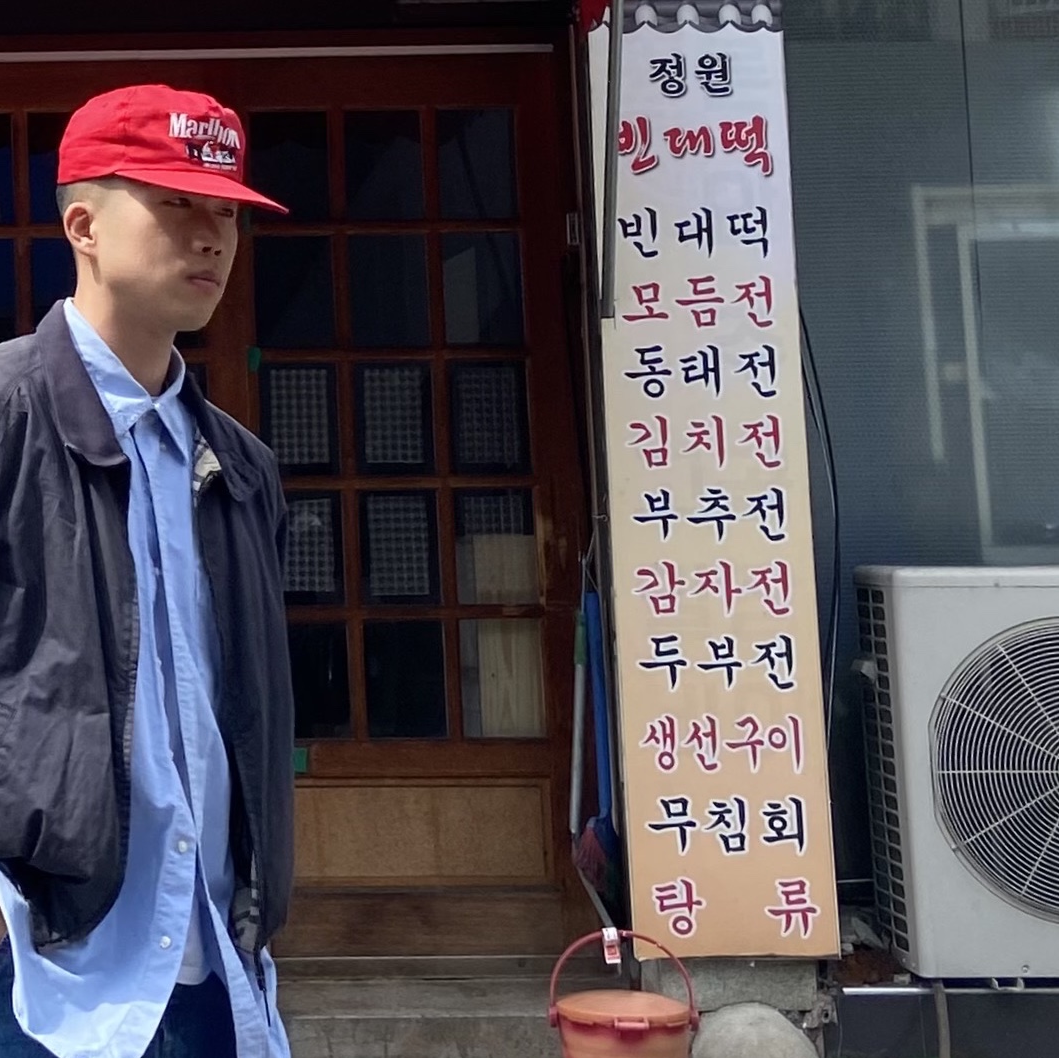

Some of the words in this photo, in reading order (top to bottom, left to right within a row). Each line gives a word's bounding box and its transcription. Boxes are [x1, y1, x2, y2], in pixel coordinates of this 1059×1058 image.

[650, 52, 733, 96] 정원
[618, 115, 771, 175] 빈대떡
[618, 206, 769, 258] 빈대떡
[622, 276, 773, 328] 모듬전
[624, 344, 777, 399] 동태전
[628, 415, 781, 468] 김치전
[633, 488, 786, 542] 부추전
[636, 561, 789, 616] 감자전
[639, 635, 794, 690] 두부전
[643, 715, 802, 772] 생선구이
[648, 797, 805, 853] 무침회
